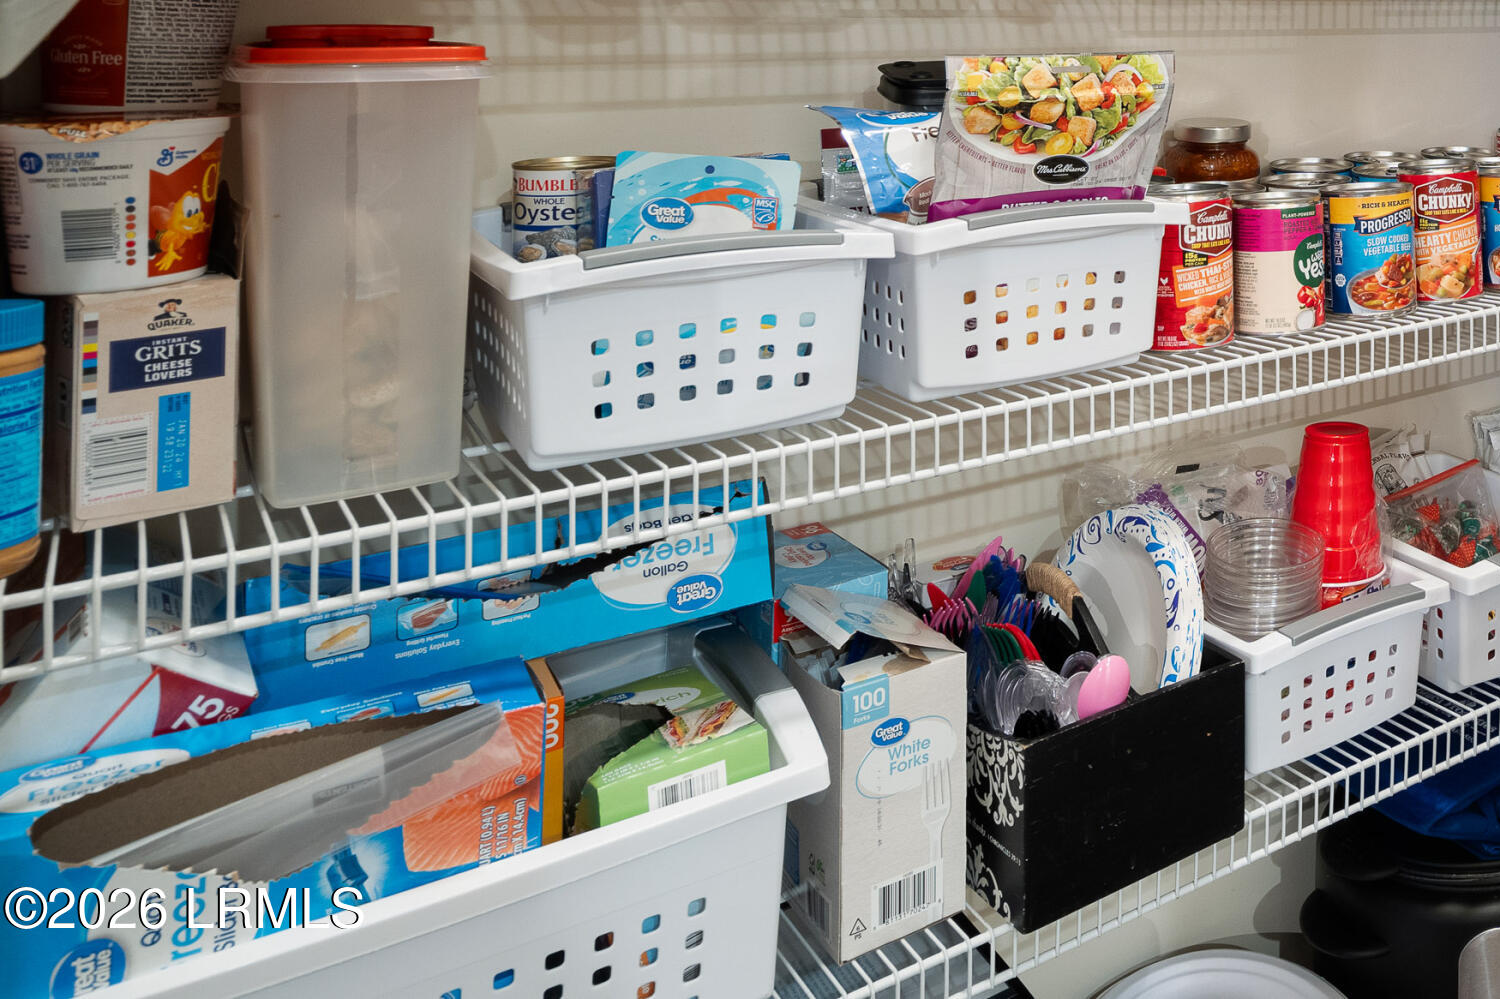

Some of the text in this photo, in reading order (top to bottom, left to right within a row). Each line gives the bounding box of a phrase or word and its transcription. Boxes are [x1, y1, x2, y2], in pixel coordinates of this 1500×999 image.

[92, 51, 123, 66] Free
[46, 151, 100, 160] WHOLE GRAIN
[46, 158, 96, 167] PER SERVING
[518, 177, 579, 192] BUMBLE
[534, 197, 565, 206] WHOLE
[755, 199, 775, 209] MSC
[1418, 193, 1472, 212] CHUNKY
[647, 204, 685, 217] Great
[1282, 210, 1316, 219] PLANT-POWERED
[656, 214, 686, 225] Value
[1360, 209, 1412, 234] PROGRESSO
[1367, 233, 1409, 247] SLOW COOKED
[1415, 224, 1479, 249] HEARTY CHICKEN
[1363, 244, 1401, 257] VEGETABLE
[1431, 235, 1479, 255] VEGETABLES
[1184, 256, 1207, 264] PROTEIN
[1176, 271, 1200, 284] WICKED
[147, 318, 195, 332] QUAKER
[152, 336, 187, 346] INSTANT
[135, 339, 202, 362] GRITS
[144, 358, 193, 373] CHEESE
[144, 367, 192, 383] LOVERS
[613, 533, 714, 572] Freezer
[643, 561, 689, 578] Gallon
[676, 581, 707, 594] Value
[677, 585, 716, 605] Great
[395, 639, 460, 660] Everyday Solutions
[852, 687, 886, 714] 100
[171, 695, 225, 729] 75
[853, 714, 871, 724] Forks
[875, 720, 904, 739] Great
[882, 728, 904, 742] Value
[888, 737, 931, 762] White
[889, 752, 930, 776] Forks
[72, 764, 123, 780] Quart
[28, 759, 164, 802] Freezer
[512, 798, 528, 835] 14.4cm)
[496, 812, 510, 851] 11/16 IN
